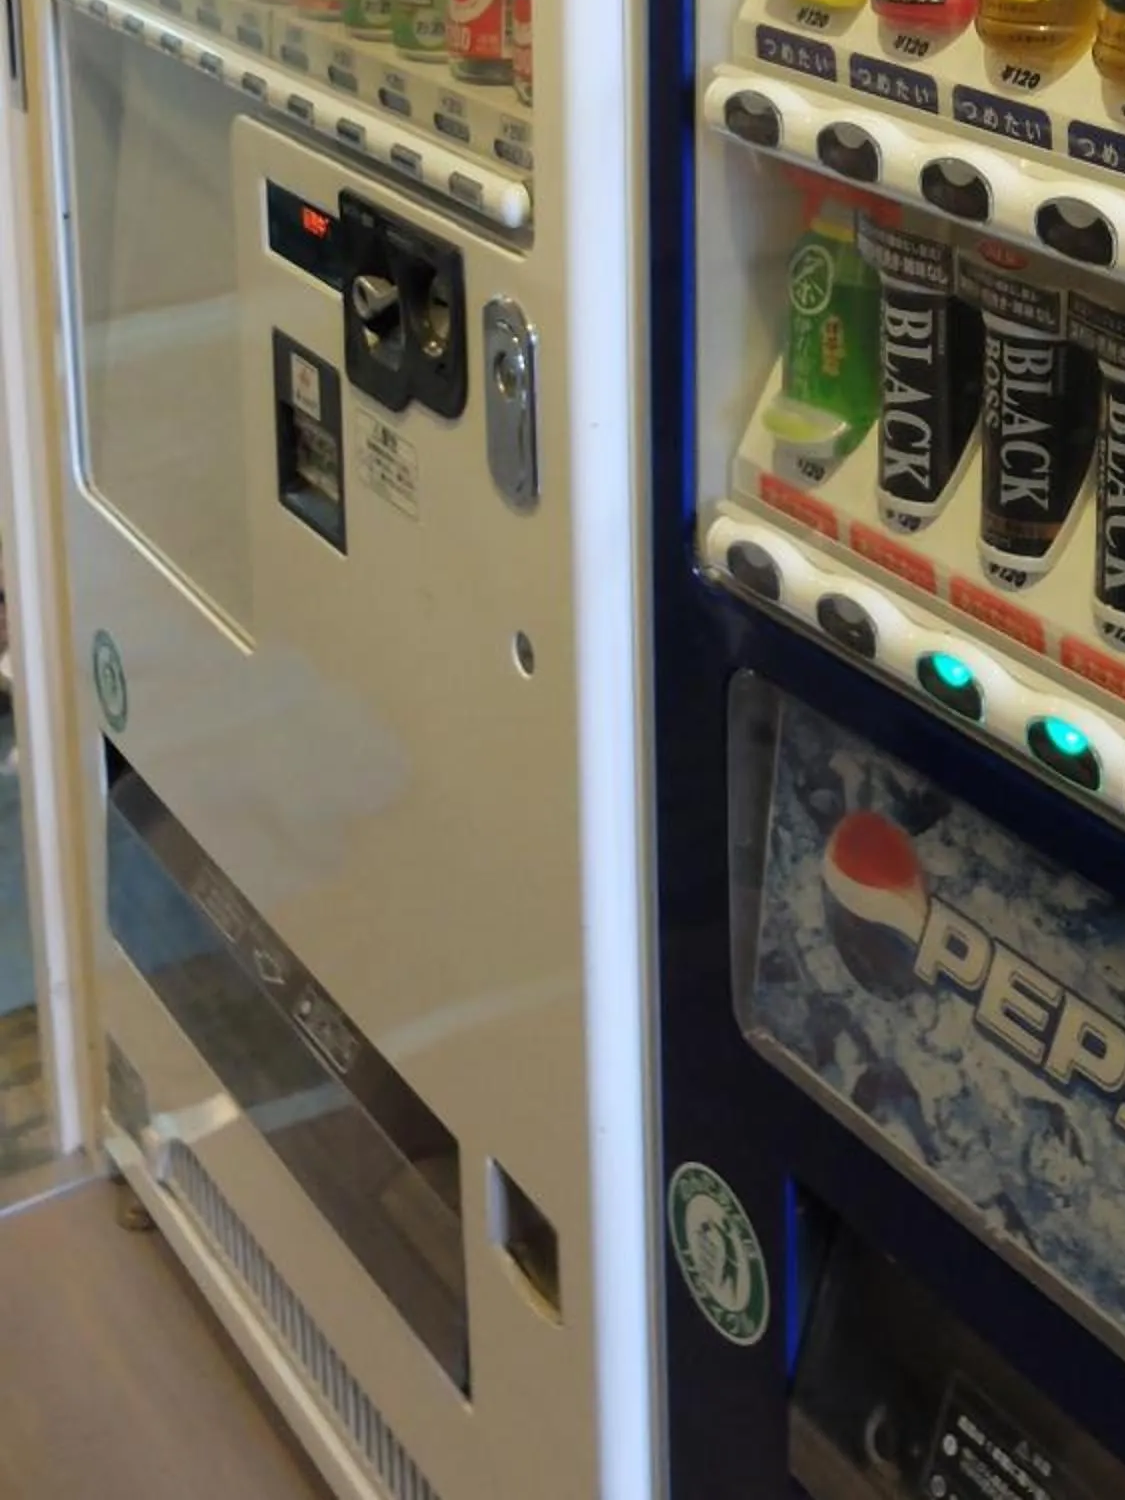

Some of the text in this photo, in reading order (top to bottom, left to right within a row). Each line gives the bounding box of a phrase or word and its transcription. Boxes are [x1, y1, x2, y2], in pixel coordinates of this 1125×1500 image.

[763, 38, 832, 73] つめたい
[854, 67, 931, 104] つめたい
[1002, 64, 1041, 90] ¥120
[960, 100, 1042, 140] つめたい
[884, 301, 933, 491] BLACK
[1000, 340, 1053, 511] BLACK
